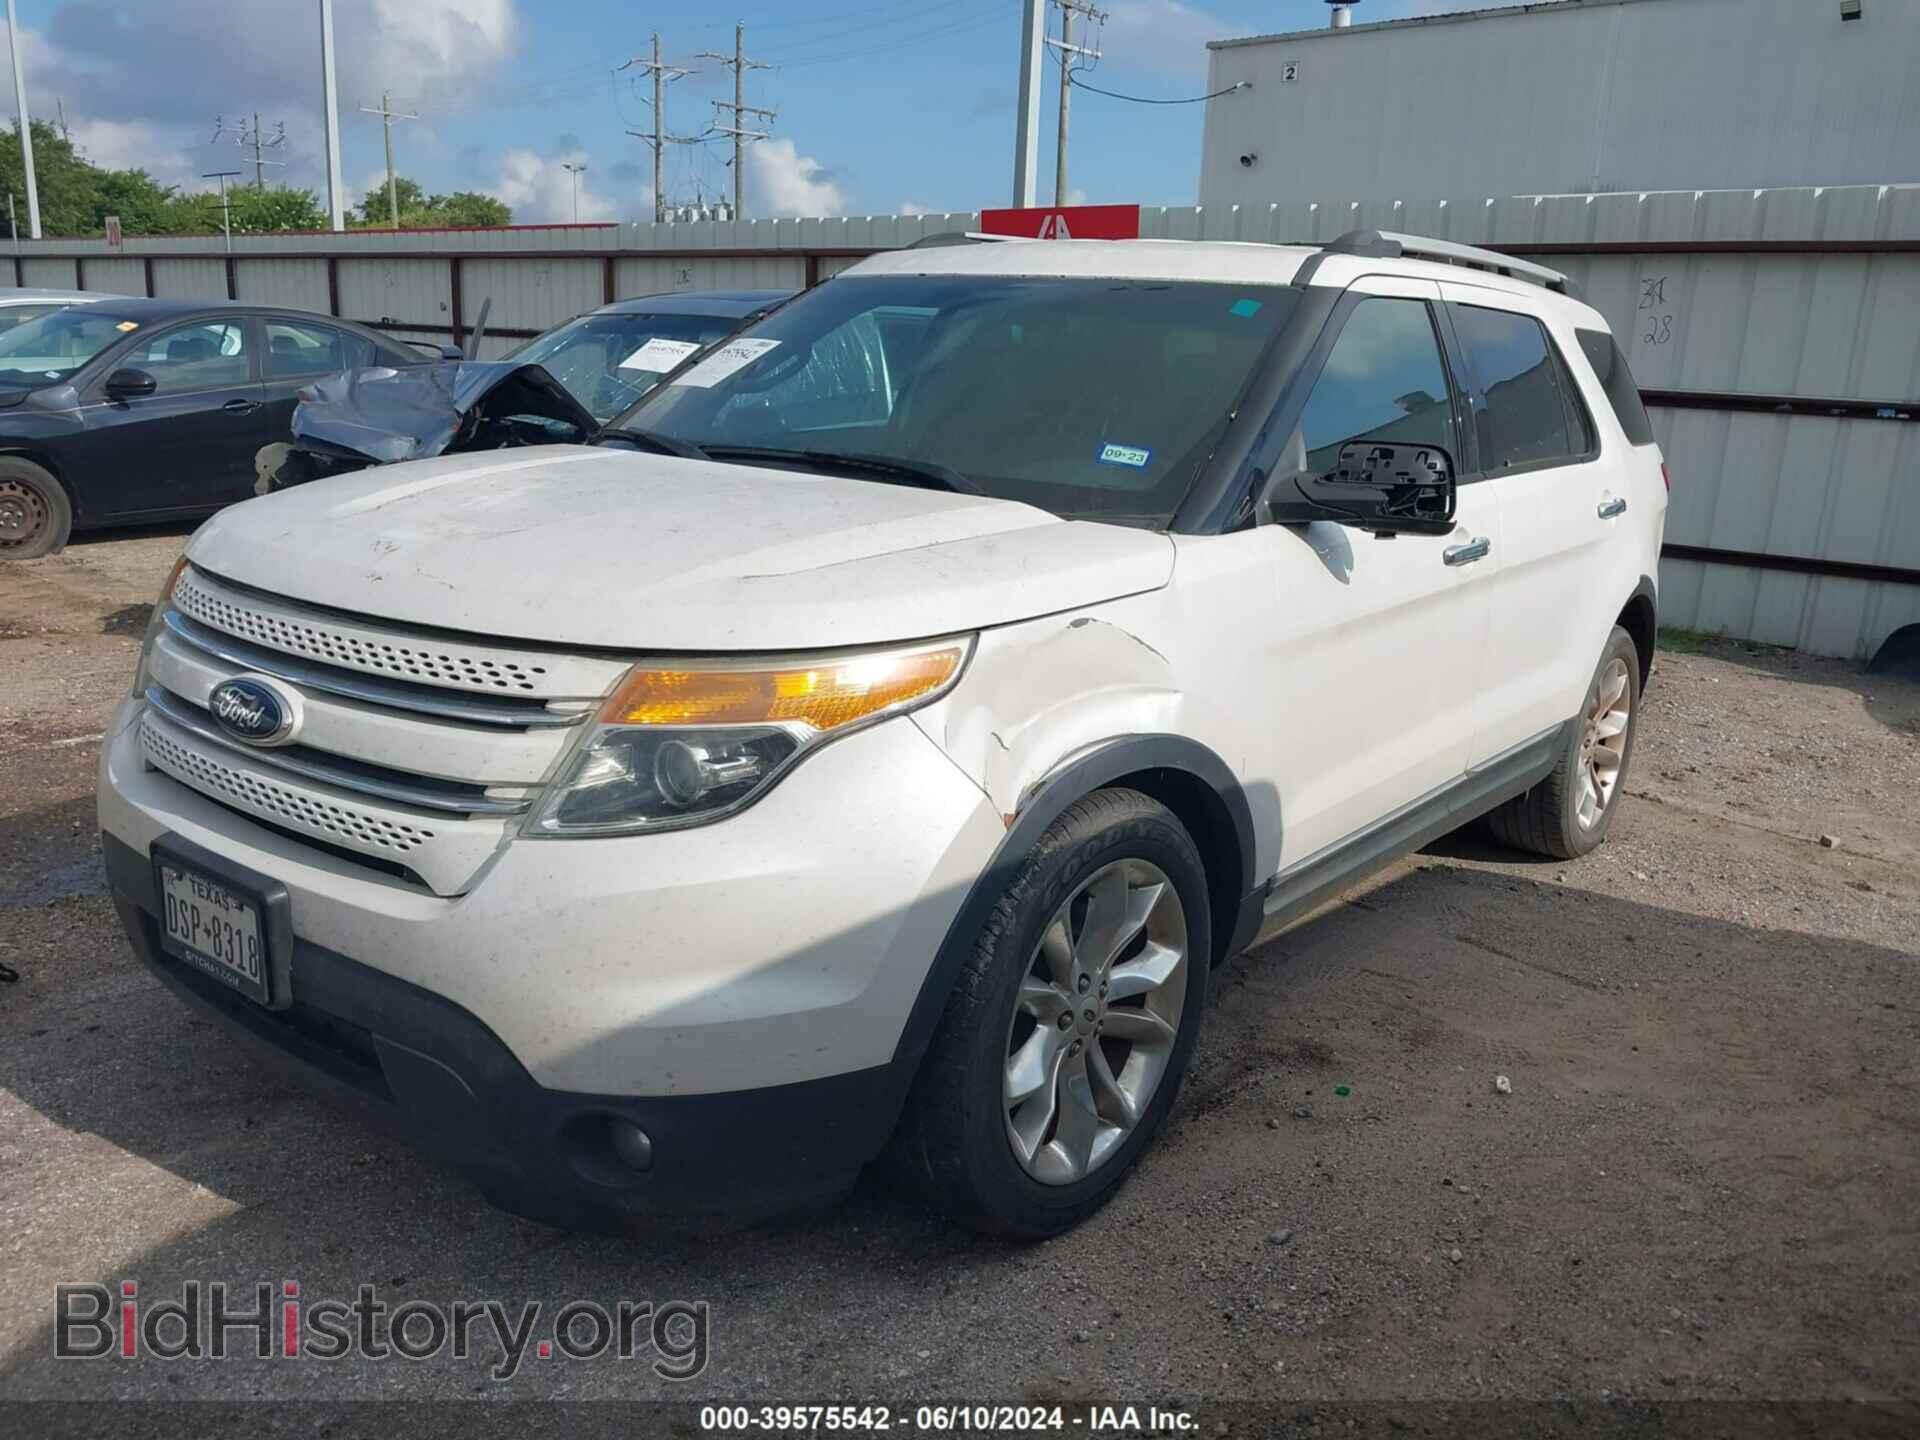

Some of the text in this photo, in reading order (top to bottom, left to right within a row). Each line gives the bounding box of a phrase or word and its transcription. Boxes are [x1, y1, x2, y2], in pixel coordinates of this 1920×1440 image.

[1285, 67, 1295, 80] 2
[213, 686, 266, 729] Ford
[190, 878, 230, 912] TEXAS
